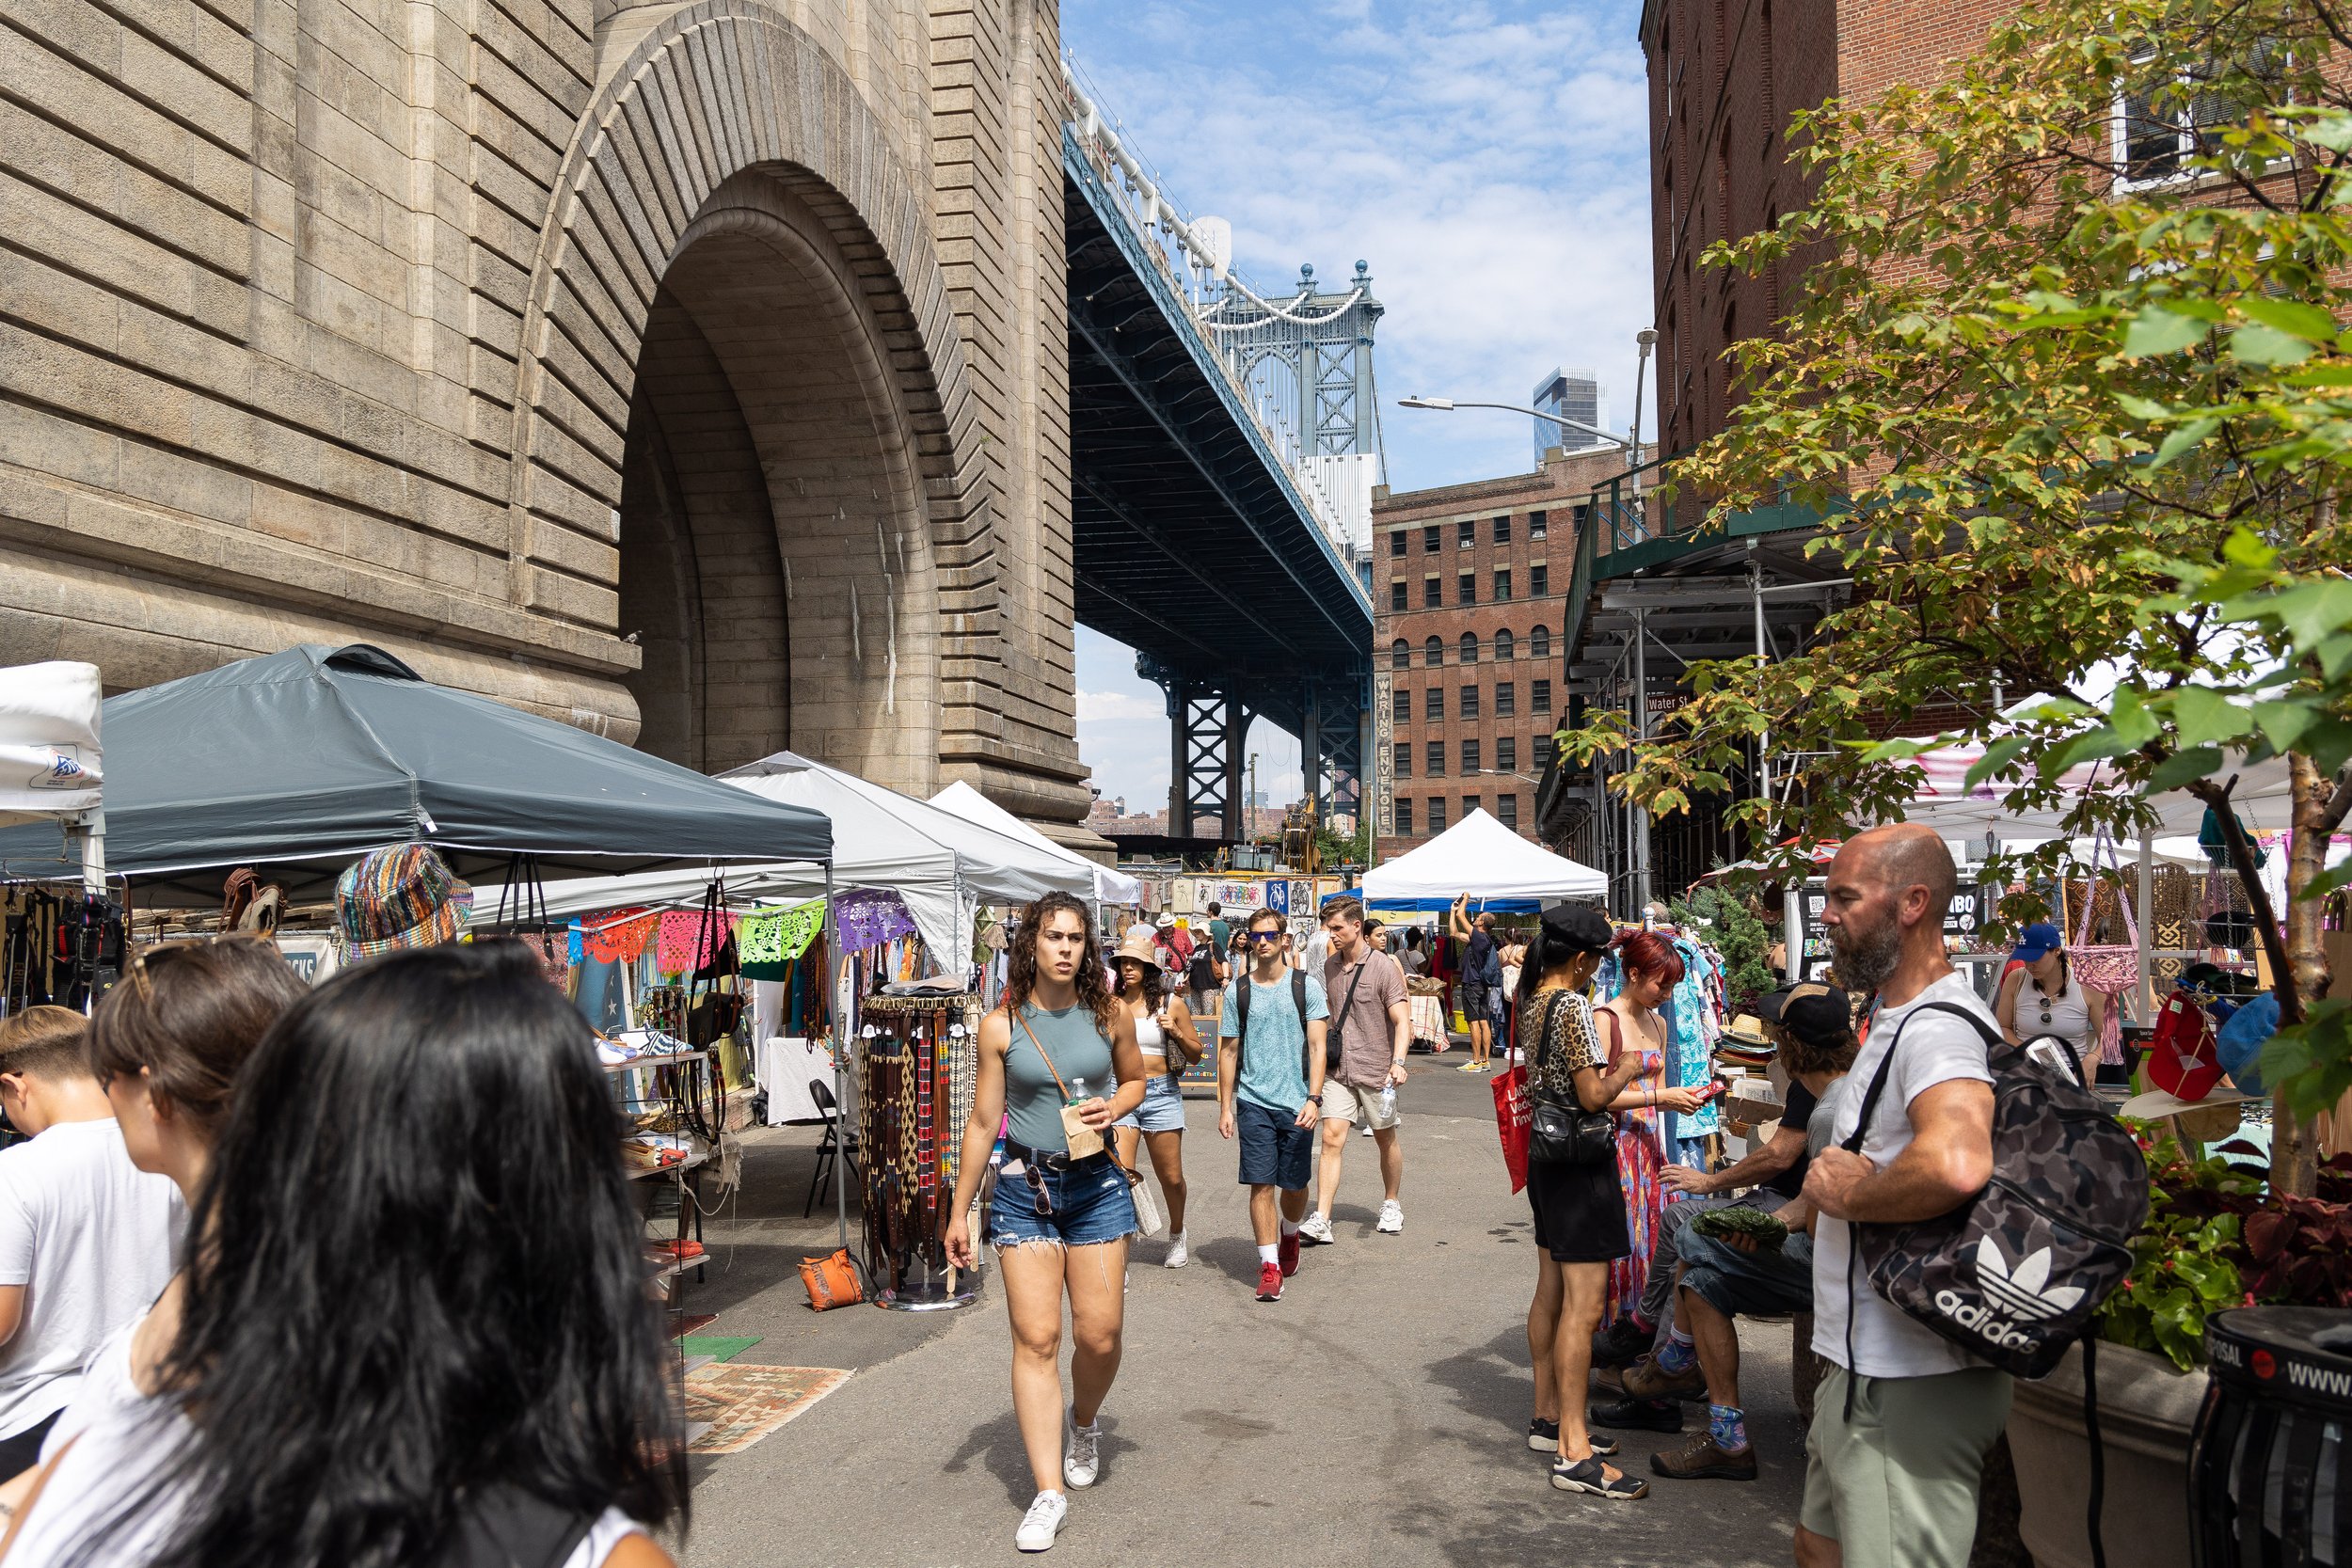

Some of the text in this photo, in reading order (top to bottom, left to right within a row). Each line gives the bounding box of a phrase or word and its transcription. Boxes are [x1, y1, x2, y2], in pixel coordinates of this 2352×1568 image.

[1649, 695, 1689, 710] Water St
[1377, 681, 1390, 825] WARING ENVELOPE
[1935, 1290, 2041, 1354] adidas
